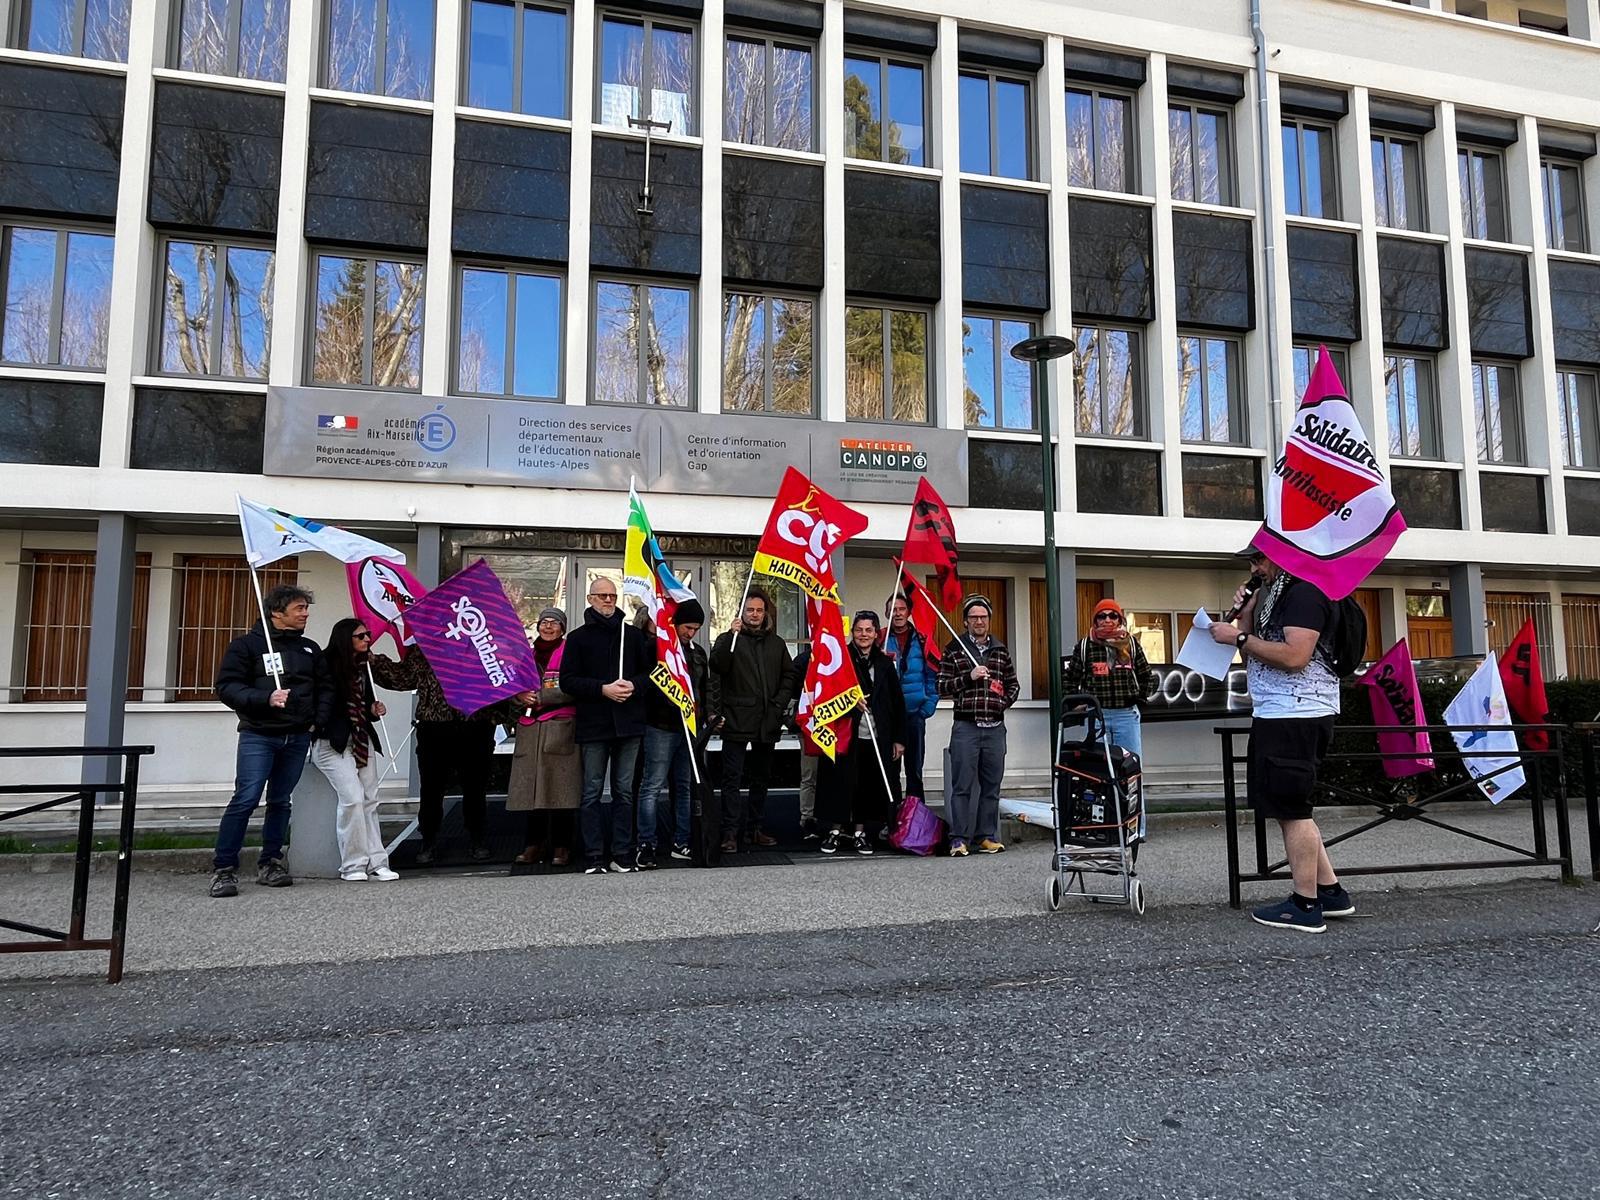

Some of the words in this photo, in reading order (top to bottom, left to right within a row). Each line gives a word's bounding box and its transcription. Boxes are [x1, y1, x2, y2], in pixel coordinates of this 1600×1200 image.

[384, 418, 425, 429] académie
[519, 417, 566, 429] Direction
[568, 420, 587, 430] des
[590, 422, 632, 433] services
[367, 428, 425, 442] Aix-Marseille
[518, 430, 604, 444] départementaux
[687, 434, 720, 445] Centre
[722, 436, 787, 448] d'information
[316, 445, 345, 455] Région
[346, 448, 396, 457] académique
[518, 444, 532, 454] de
[534, 444, 591, 457] l'éducation
[593, 449, 641, 460] nationale
[841, 441, 912, 452] LATELIER
[1295, 413, 1384, 480] Solidaire
[687, 448, 698, 457] et
[700, 448, 761, 460] d'orientation
[842, 452, 927, 469] CANOPÉ
[316, 457, 416, 468] PROVENCE-ALPES-CÔTE
[418, 461, 448, 469] D'AZUR
[518, 458, 590, 471] Hautes-Alpes
[687, 461, 708, 472] Gap
[1275, 455, 1352, 522] Antifasciste
